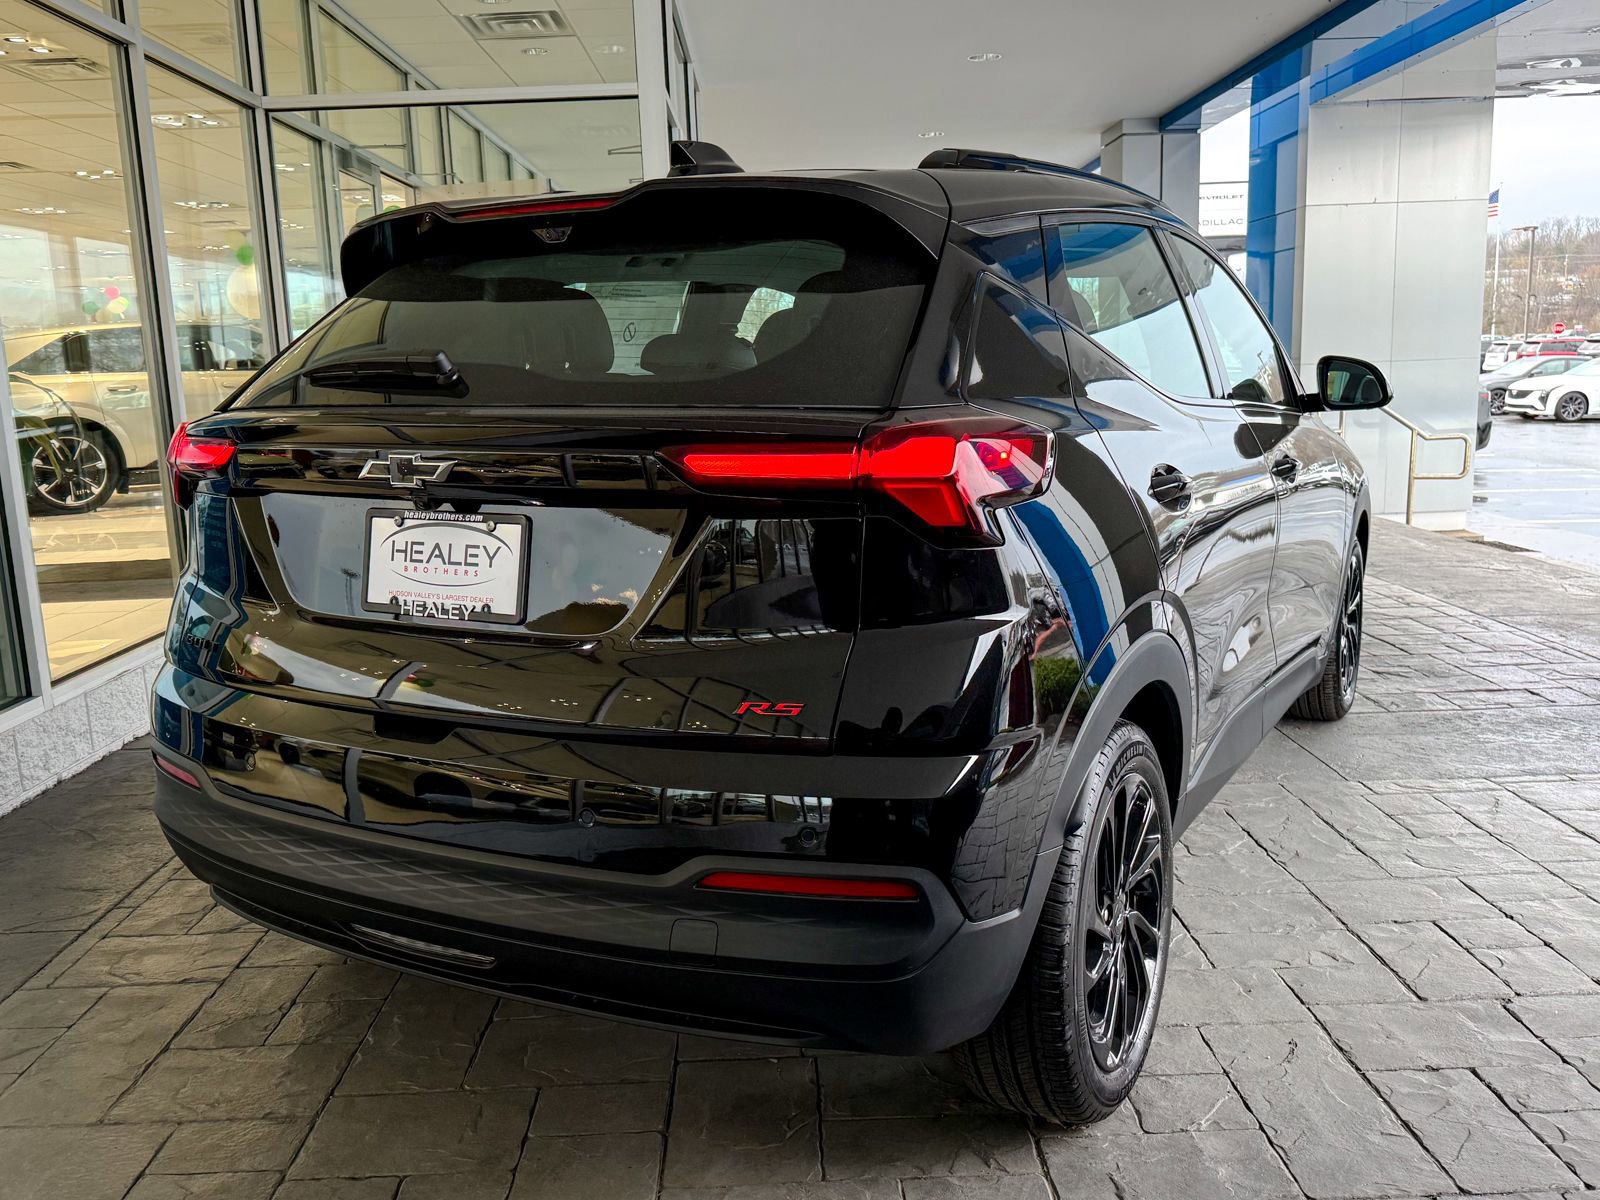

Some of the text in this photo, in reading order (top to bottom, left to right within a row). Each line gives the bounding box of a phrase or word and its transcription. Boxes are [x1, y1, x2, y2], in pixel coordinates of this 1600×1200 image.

[404, 510, 483, 522] healeybrothers.com
[391, 540, 502, 568] HEALEY
[404, 566, 479, 577] BROTHERS
[388, 590, 494, 604] HUDSON VALLEY'S LARGEST DEALER
[401, 600, 474, 621] HEALEY
[734, 701, 805, 717] RS
